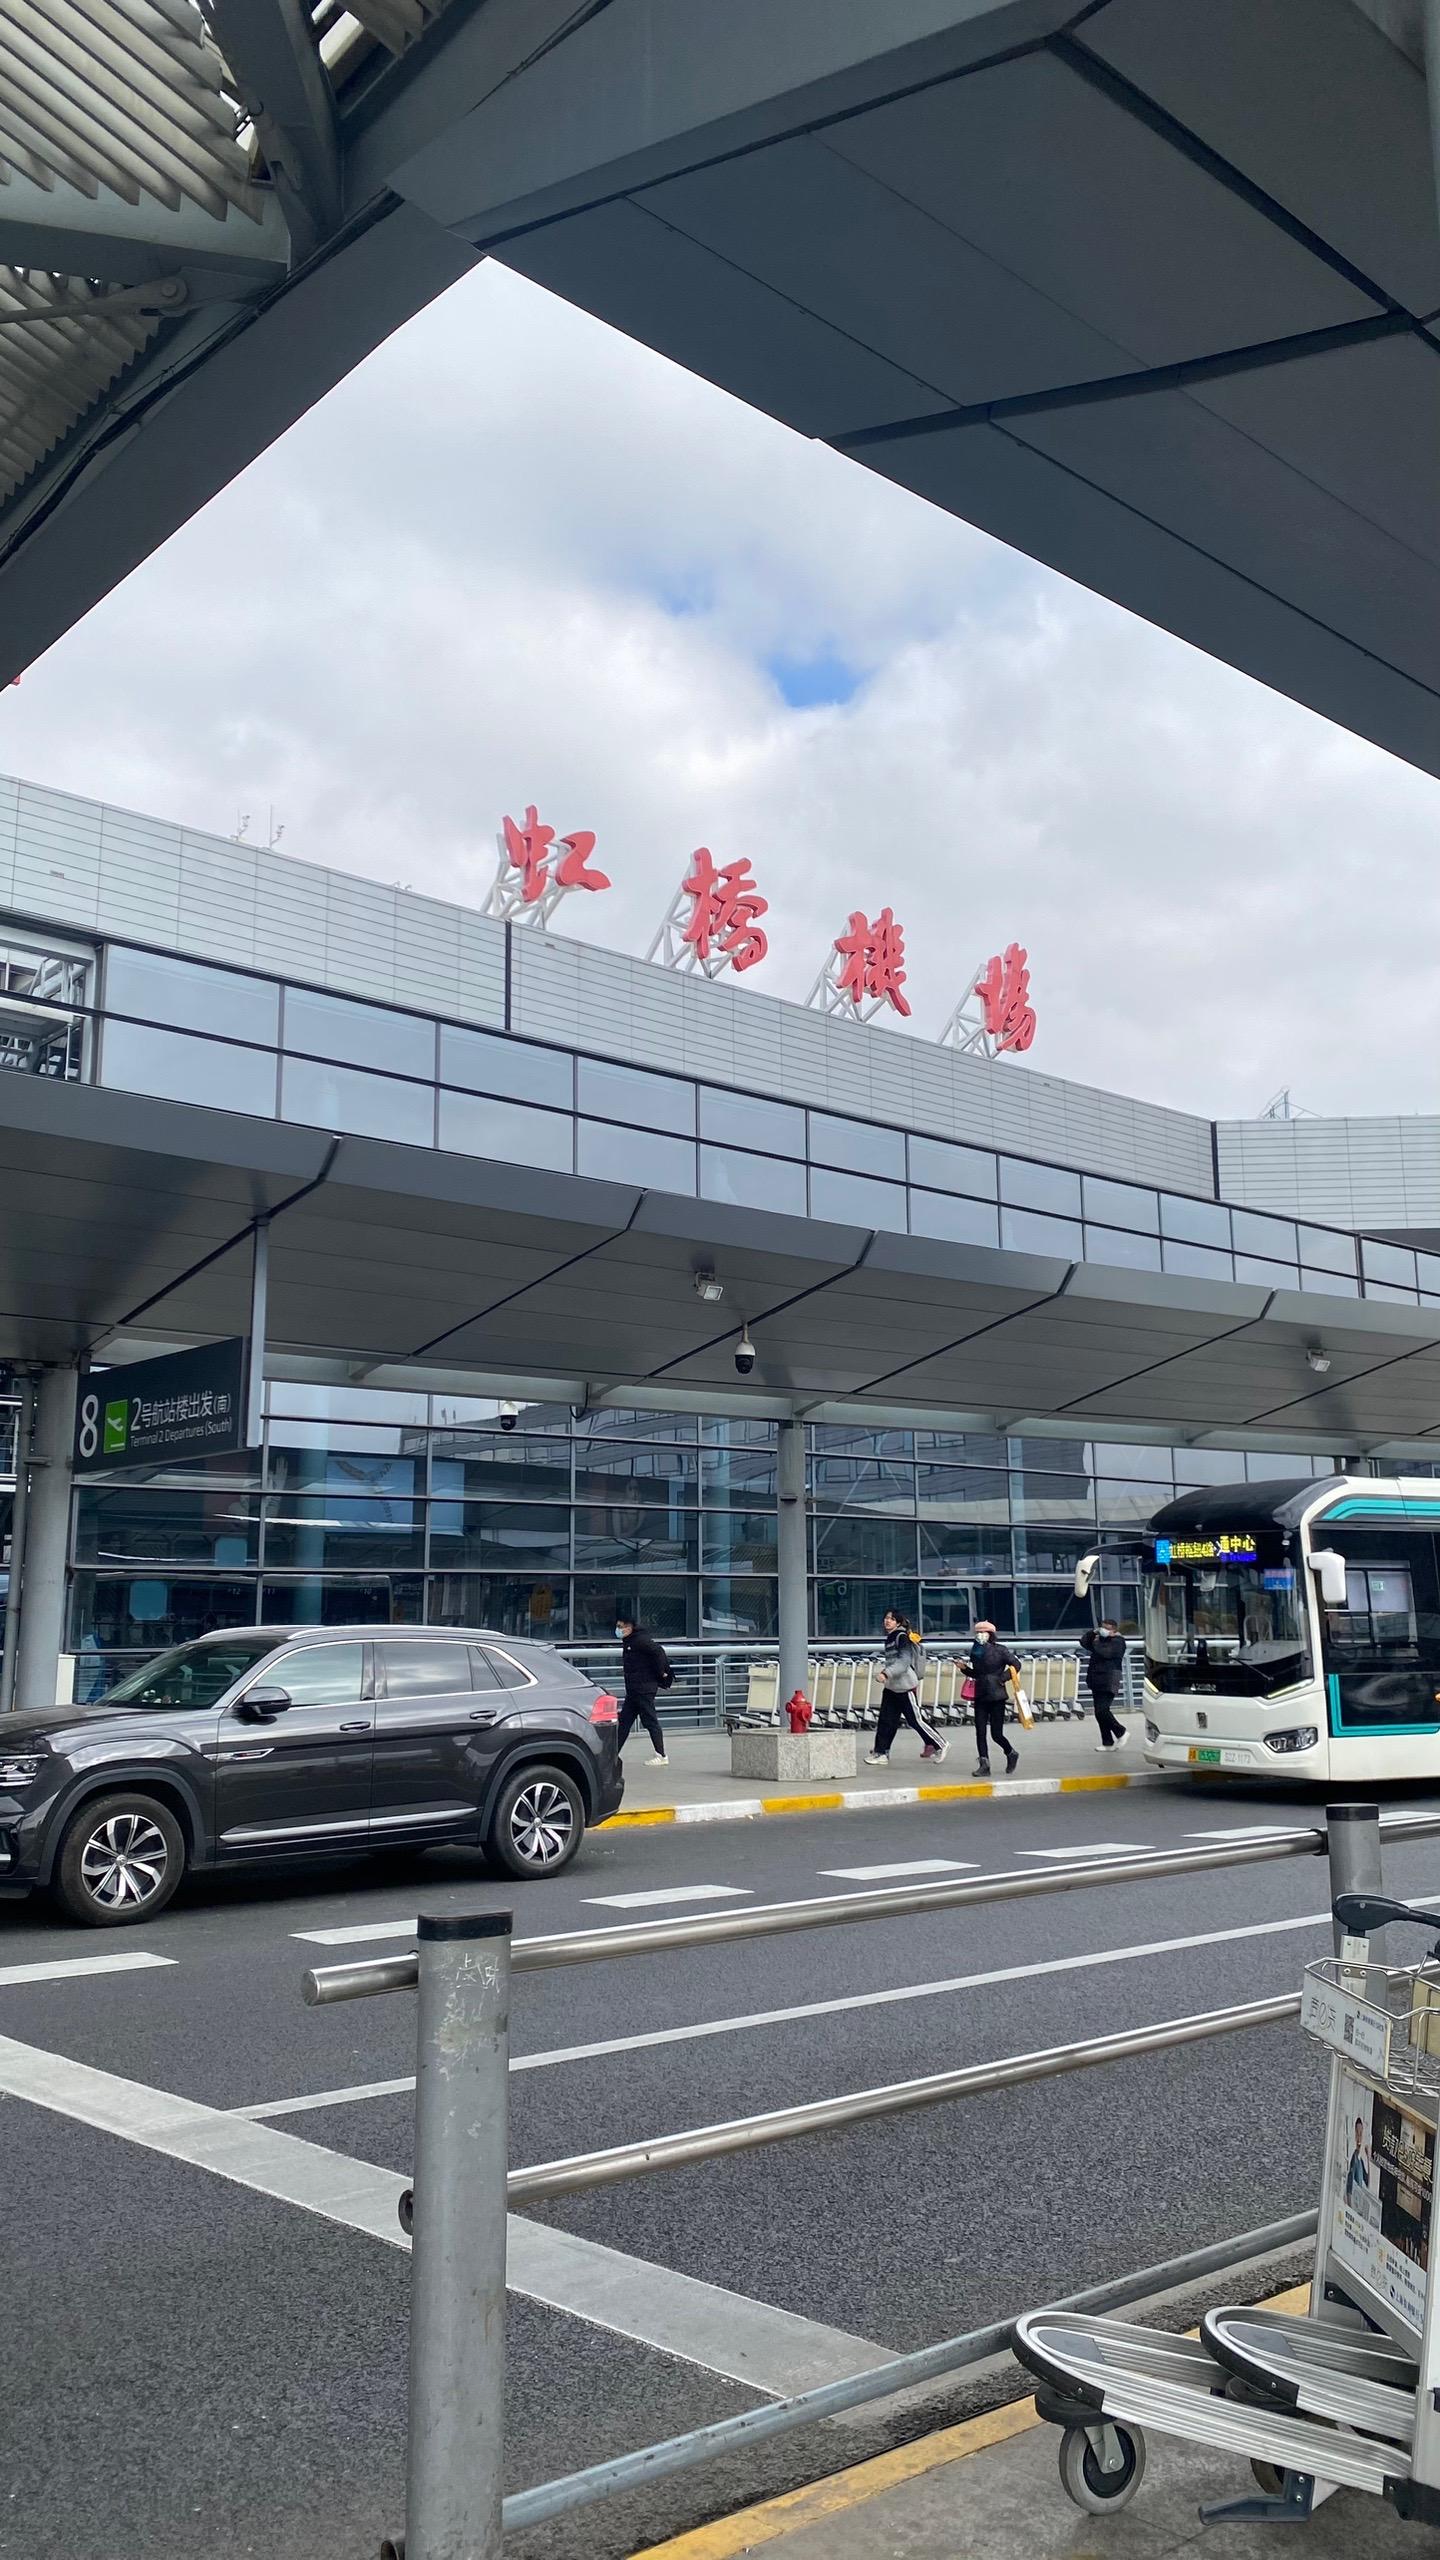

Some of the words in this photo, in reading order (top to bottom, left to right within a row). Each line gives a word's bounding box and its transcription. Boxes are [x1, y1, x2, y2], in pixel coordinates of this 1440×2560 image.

[501, 805, 1037, 1052] 虹橋機場
[79, 1394, 98, 1458] 8
[130, 1434, 159, 1448] Terminal
[159, 1431, 164, 1444] 2
[164, 1426, 205, 1443] Departures
[205, 1418, 232, 1437] (South)
